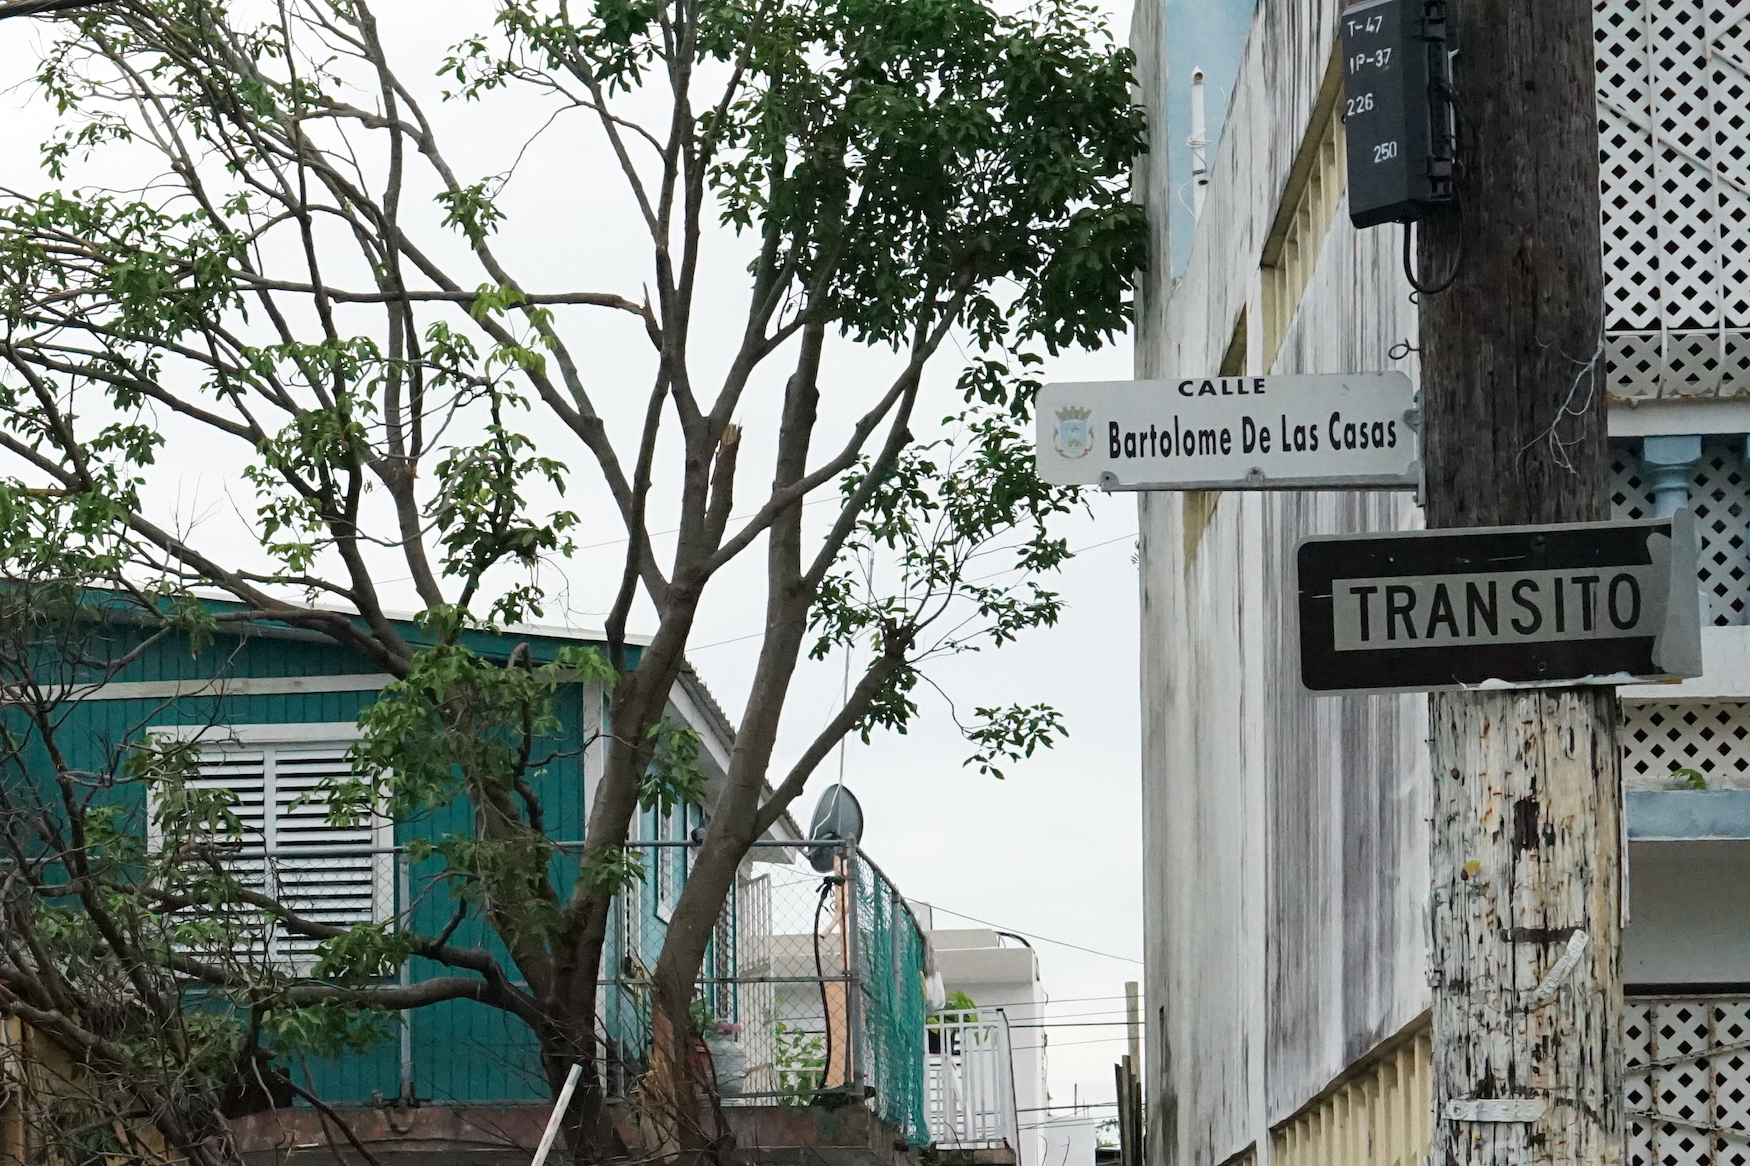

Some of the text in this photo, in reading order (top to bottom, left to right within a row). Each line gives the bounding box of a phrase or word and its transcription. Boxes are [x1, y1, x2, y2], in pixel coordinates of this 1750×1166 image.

[1347, 15, 1383, 37] T-47
[1347, 92, 1374, 116] 226
[1374, 141, 1397, 163] 250
[1178, 378, 1266, 397] CALLE
[1109, 411, 1397, 459] Bartolome De Las Casas
[1349, 573, 1641, 642] TRANSITO
